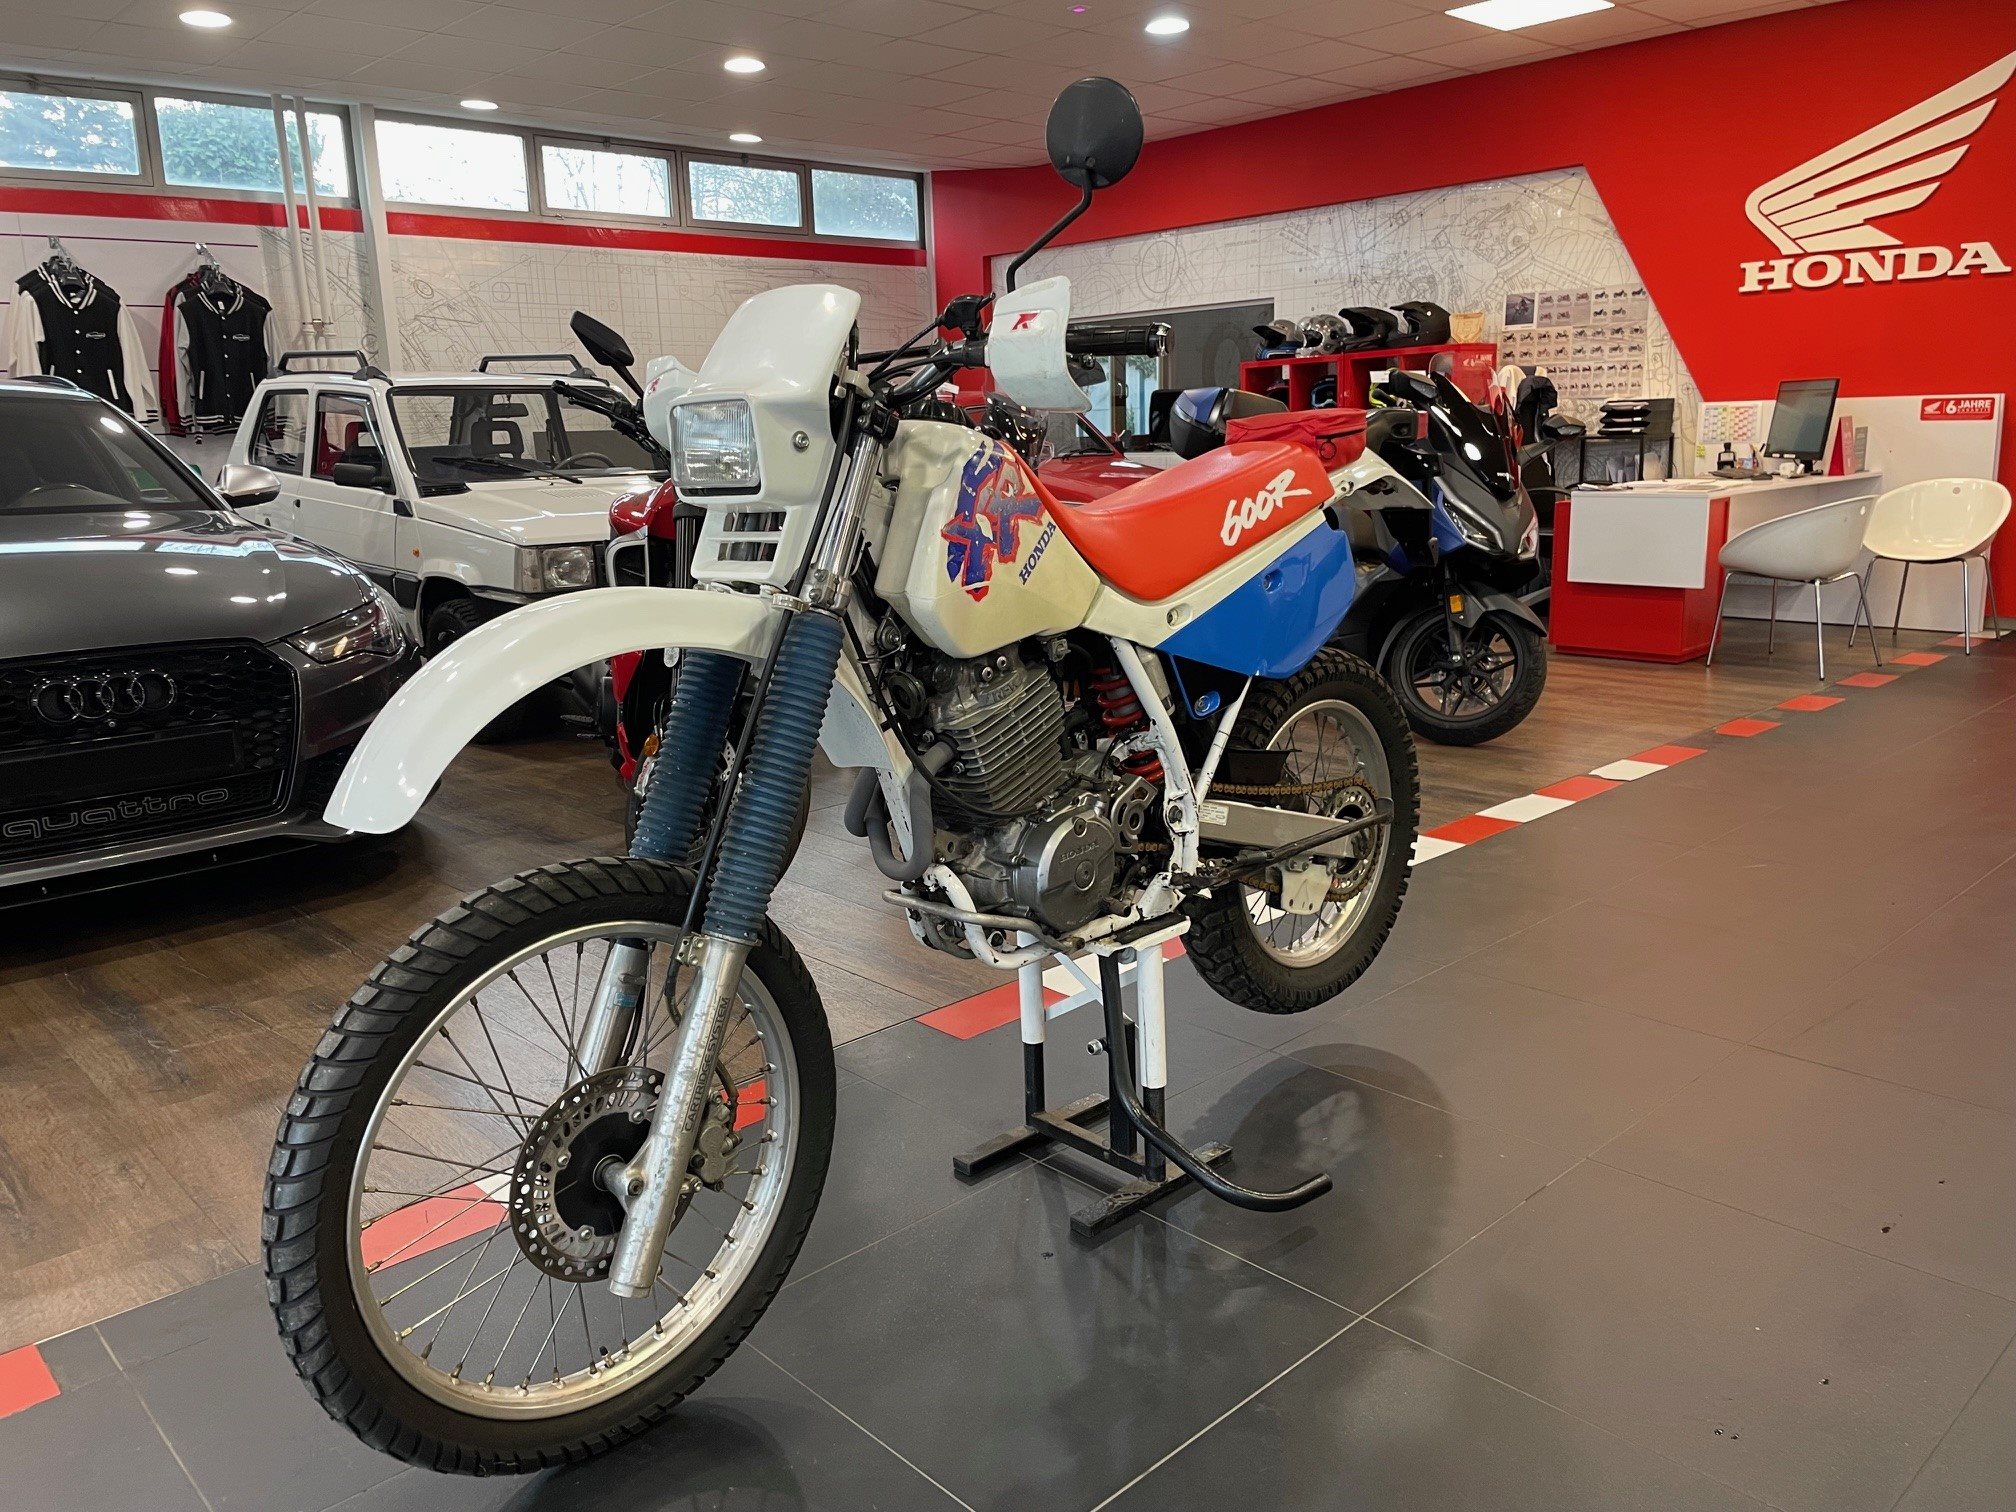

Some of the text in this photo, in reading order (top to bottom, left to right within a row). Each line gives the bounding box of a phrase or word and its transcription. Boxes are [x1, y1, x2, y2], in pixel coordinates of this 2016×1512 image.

[1738, 242, 2012, 293] HONDA
[1945, 400, 1992, 414] 6 JAHRE
[1220, 468, 1312, 546] 600R
[1019, 521, 1057, 585] HONDA
[3, 788, 228, 838] quattro
[684, 997, 729, 1132] CARTRIDGE SYSTEM
